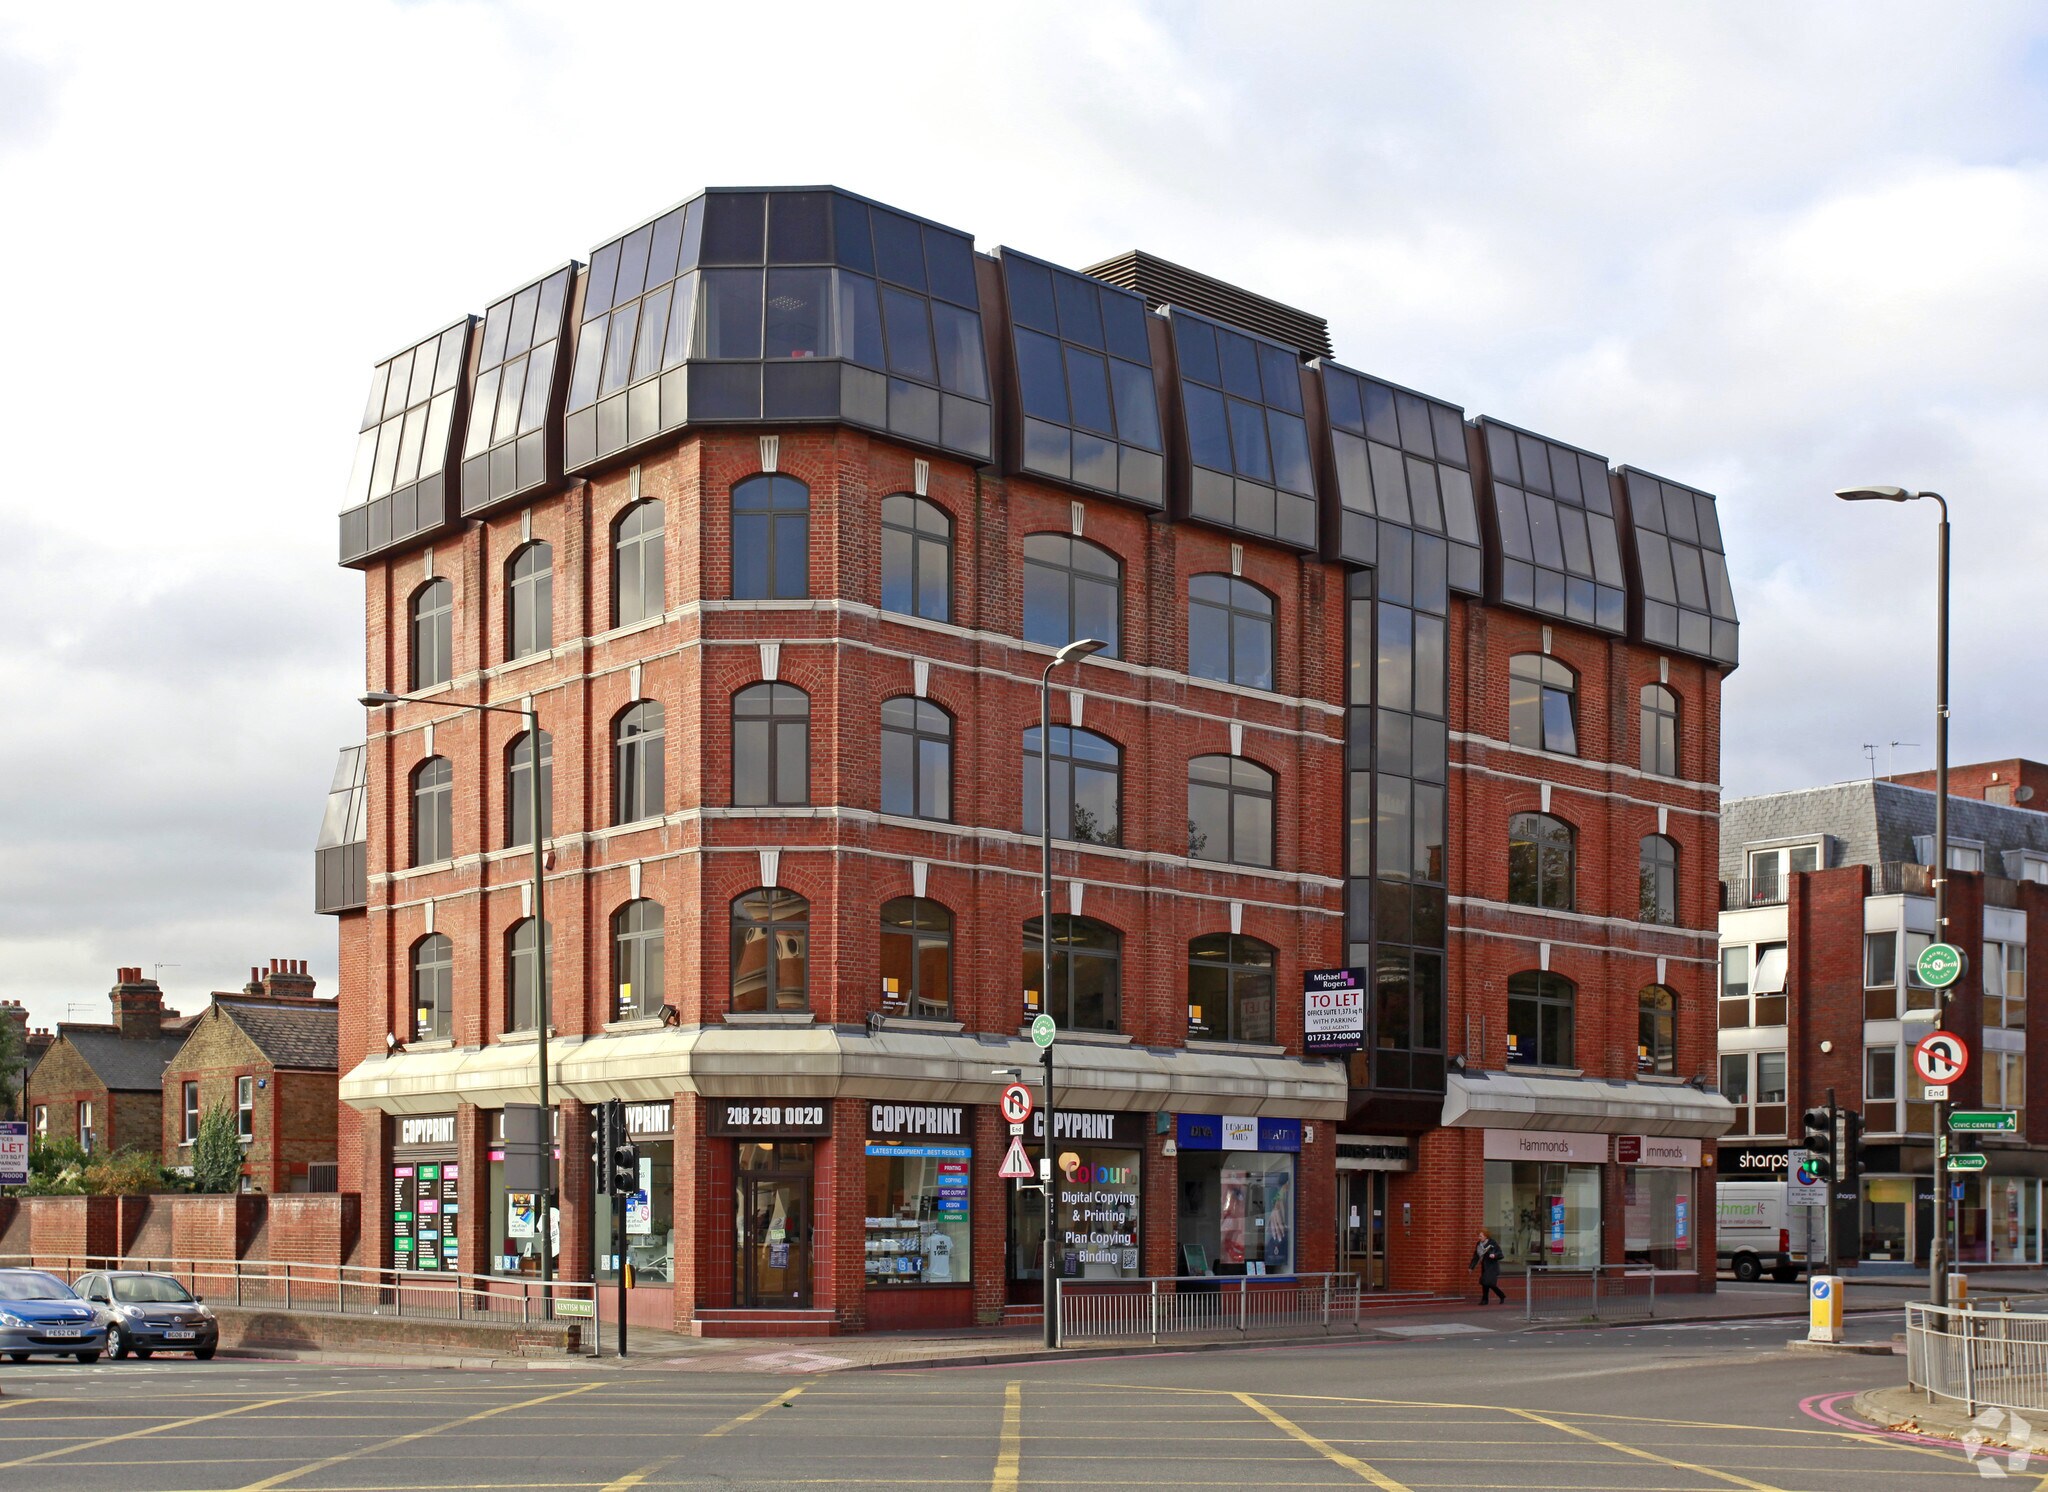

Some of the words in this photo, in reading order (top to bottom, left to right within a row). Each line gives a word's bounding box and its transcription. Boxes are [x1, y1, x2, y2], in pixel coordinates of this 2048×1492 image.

[1926, 951, 1950, 961] BROMLEY
[1926, 970, 1950, 979] VILLAGE
[1323, 981, 1346, 989] Rogers
[1311, 994, 1330, 1008] TO
[1336, 993, 1360, 1006] LET
[1308, 1034, 1331, 1042] 01732
[1333, 1032, 1360, 1040] 740000
[626, 1104, 670, 1132] YPRINT
[727, 1107, 750, 1124] 208
[752, 1107, 780, 1124] 290
[785, 1107, 822, 1124] 0020
[872, 1105, 962, 1134] COPYPRINT
[402, 1117, 454, 1143] COPYPRINT
[1034, 1111, 1114, 1140] CPYPRINT
[1190, 1126, 1212, 1138] DIVA
[1262, 1130, 1296, 1140] BEAUTY
[2, 1143, 24, 1152] LET
[1520, 1138, 1568, 1152] Hammonds
[1646, 1146, 1682, 1158] mmonds
[1740, 1150, 1788, 1172] sharps
[1066, 1161, 1132, 1184] Colour
[1062, 1192, 1092, 1205] Digital
[1094, 1191, 1136, 1205] Copying
[1716, 1202, 1765, 1215] chmark
[1072, 1210, 1080, 1221] &
[1084, 1210, 1125, 1224] Printing
[1065, 1232, 1087, 1243] Plan
[1090, 1231, 1131, 1246] Copying
[1079, 1250, 1118, 1264] Binding
[557, 1303, 578, 1311] KENTISH
